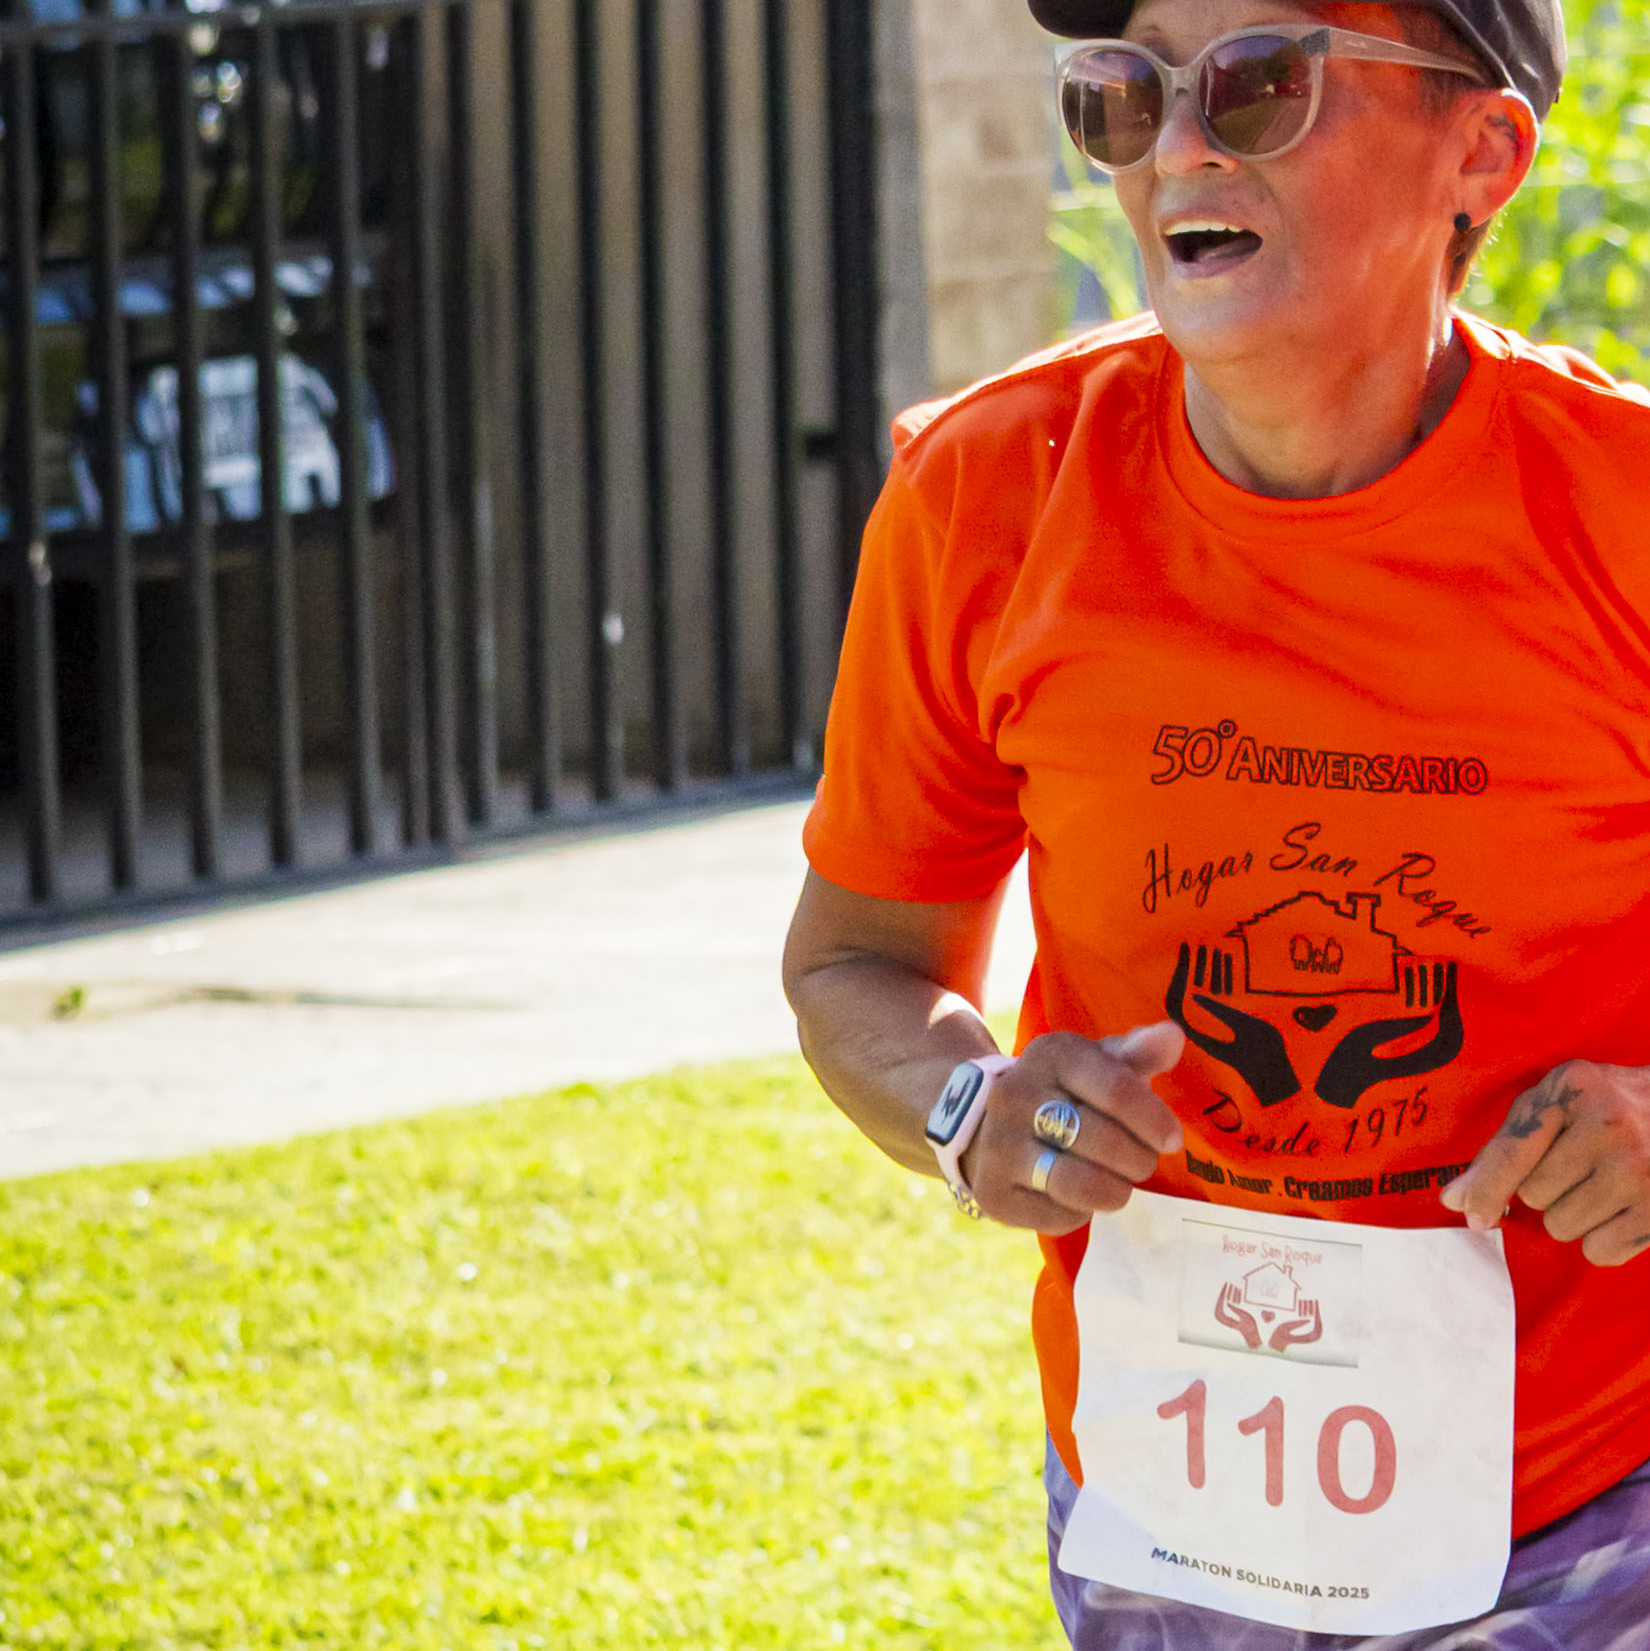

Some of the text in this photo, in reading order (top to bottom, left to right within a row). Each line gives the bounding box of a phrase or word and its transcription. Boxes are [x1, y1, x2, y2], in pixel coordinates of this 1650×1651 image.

[1143, 821, 1492, 939] Hogar San Roque
[1202, 1086, 1429, 1157] Desde 1975
[1222, 1234, 1323, 1268] Hogar San Roque
[1156, 1378, 1398, 1516] 110
[1150, 1547, 1371, 1600] MARATON SOLIDARIA 2025
